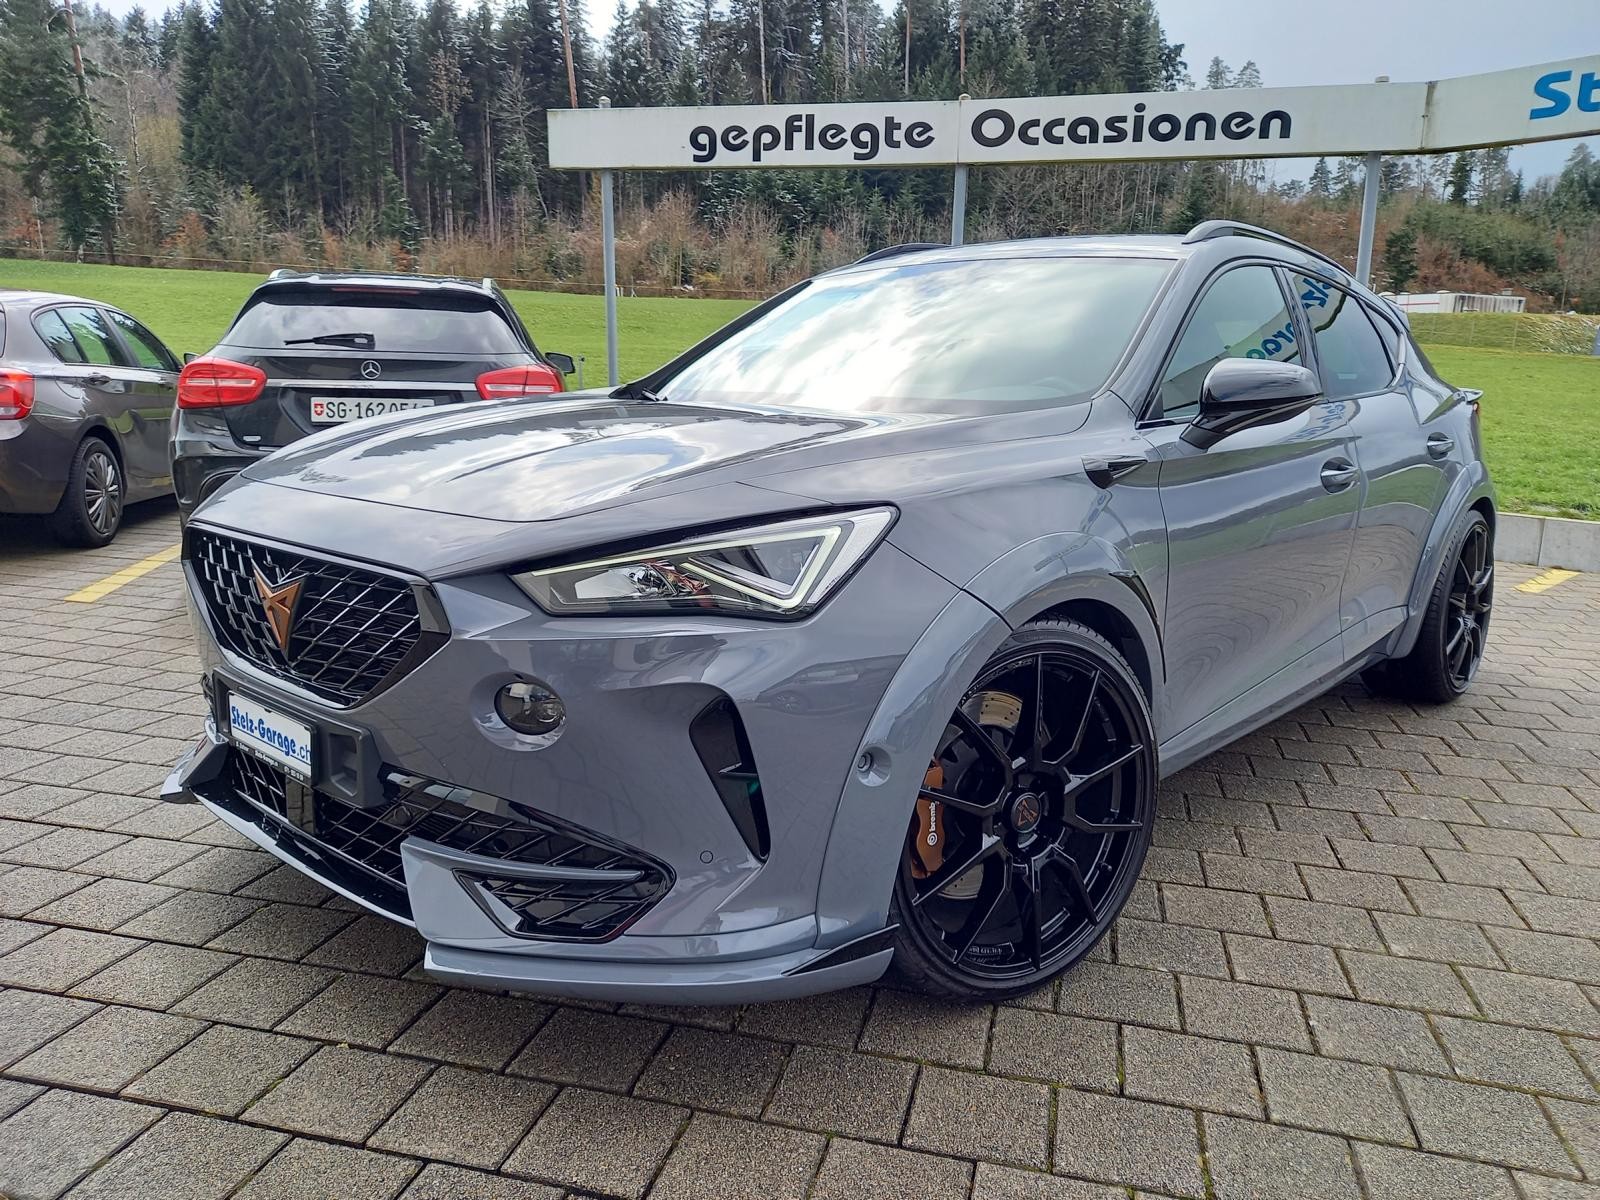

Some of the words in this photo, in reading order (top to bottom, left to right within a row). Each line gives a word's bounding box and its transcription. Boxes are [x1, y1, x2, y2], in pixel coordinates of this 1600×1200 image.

[689, 113, 936, 163] gepflegte
[971, 102, 1292, 147] Occasionen
[231, 705, 310, 761] Stelz-Garage.ch
